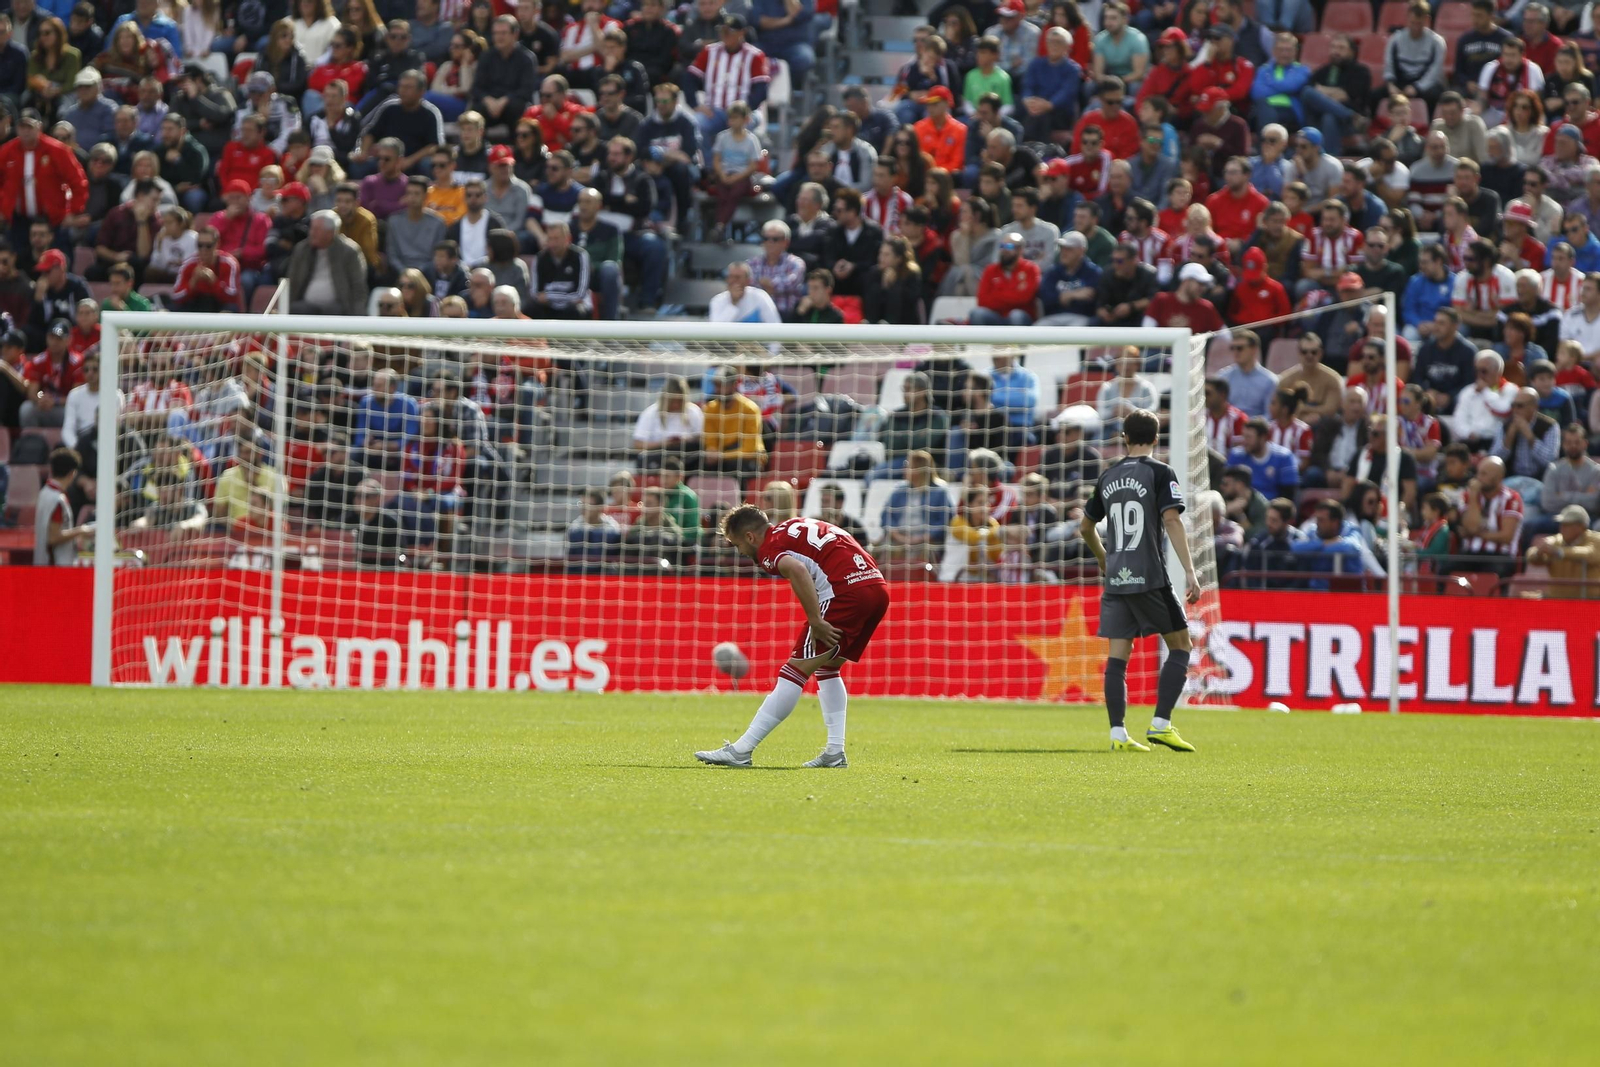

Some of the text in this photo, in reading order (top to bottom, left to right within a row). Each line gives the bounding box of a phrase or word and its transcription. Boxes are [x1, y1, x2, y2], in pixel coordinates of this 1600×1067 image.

[1102, 477, 1148, 499] GUILLERMO
[1109, 500, 1145, 551] 19
[143, 616, 610, 692] williamhill.es
